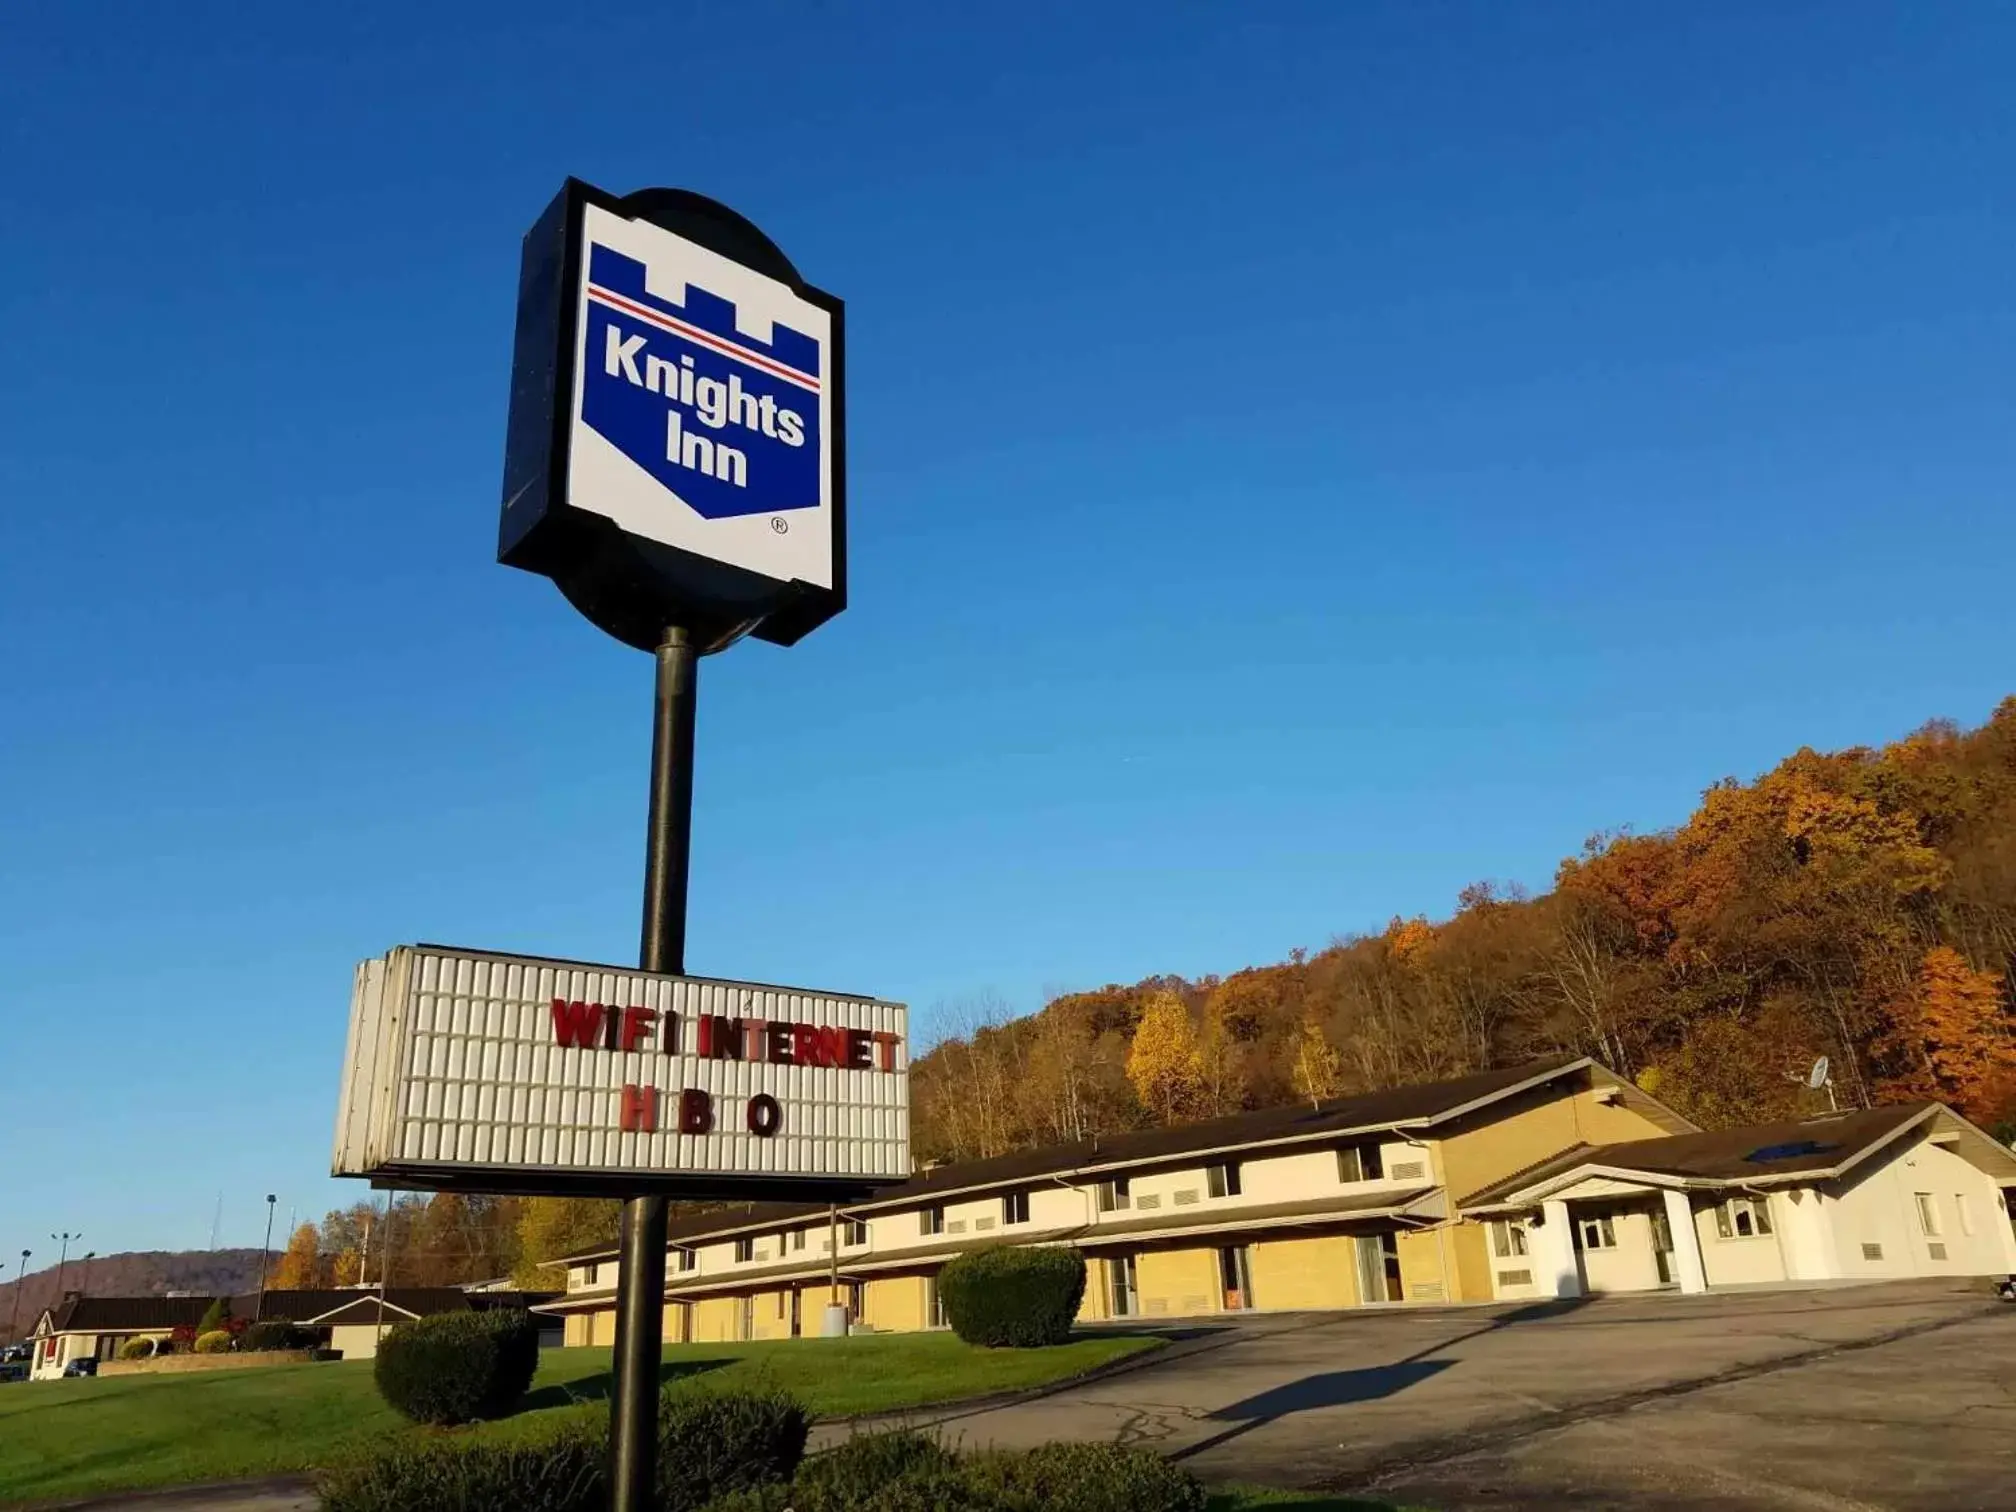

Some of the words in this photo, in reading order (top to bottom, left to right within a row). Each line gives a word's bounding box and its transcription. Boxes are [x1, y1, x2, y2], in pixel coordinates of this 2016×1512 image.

[604, 325, 805, 447] Knights
[666, 410, 747, 488] Inn
[553, 998, 676, 1055] WIFI
[700, 1014, 900, 1073] INTERNET
